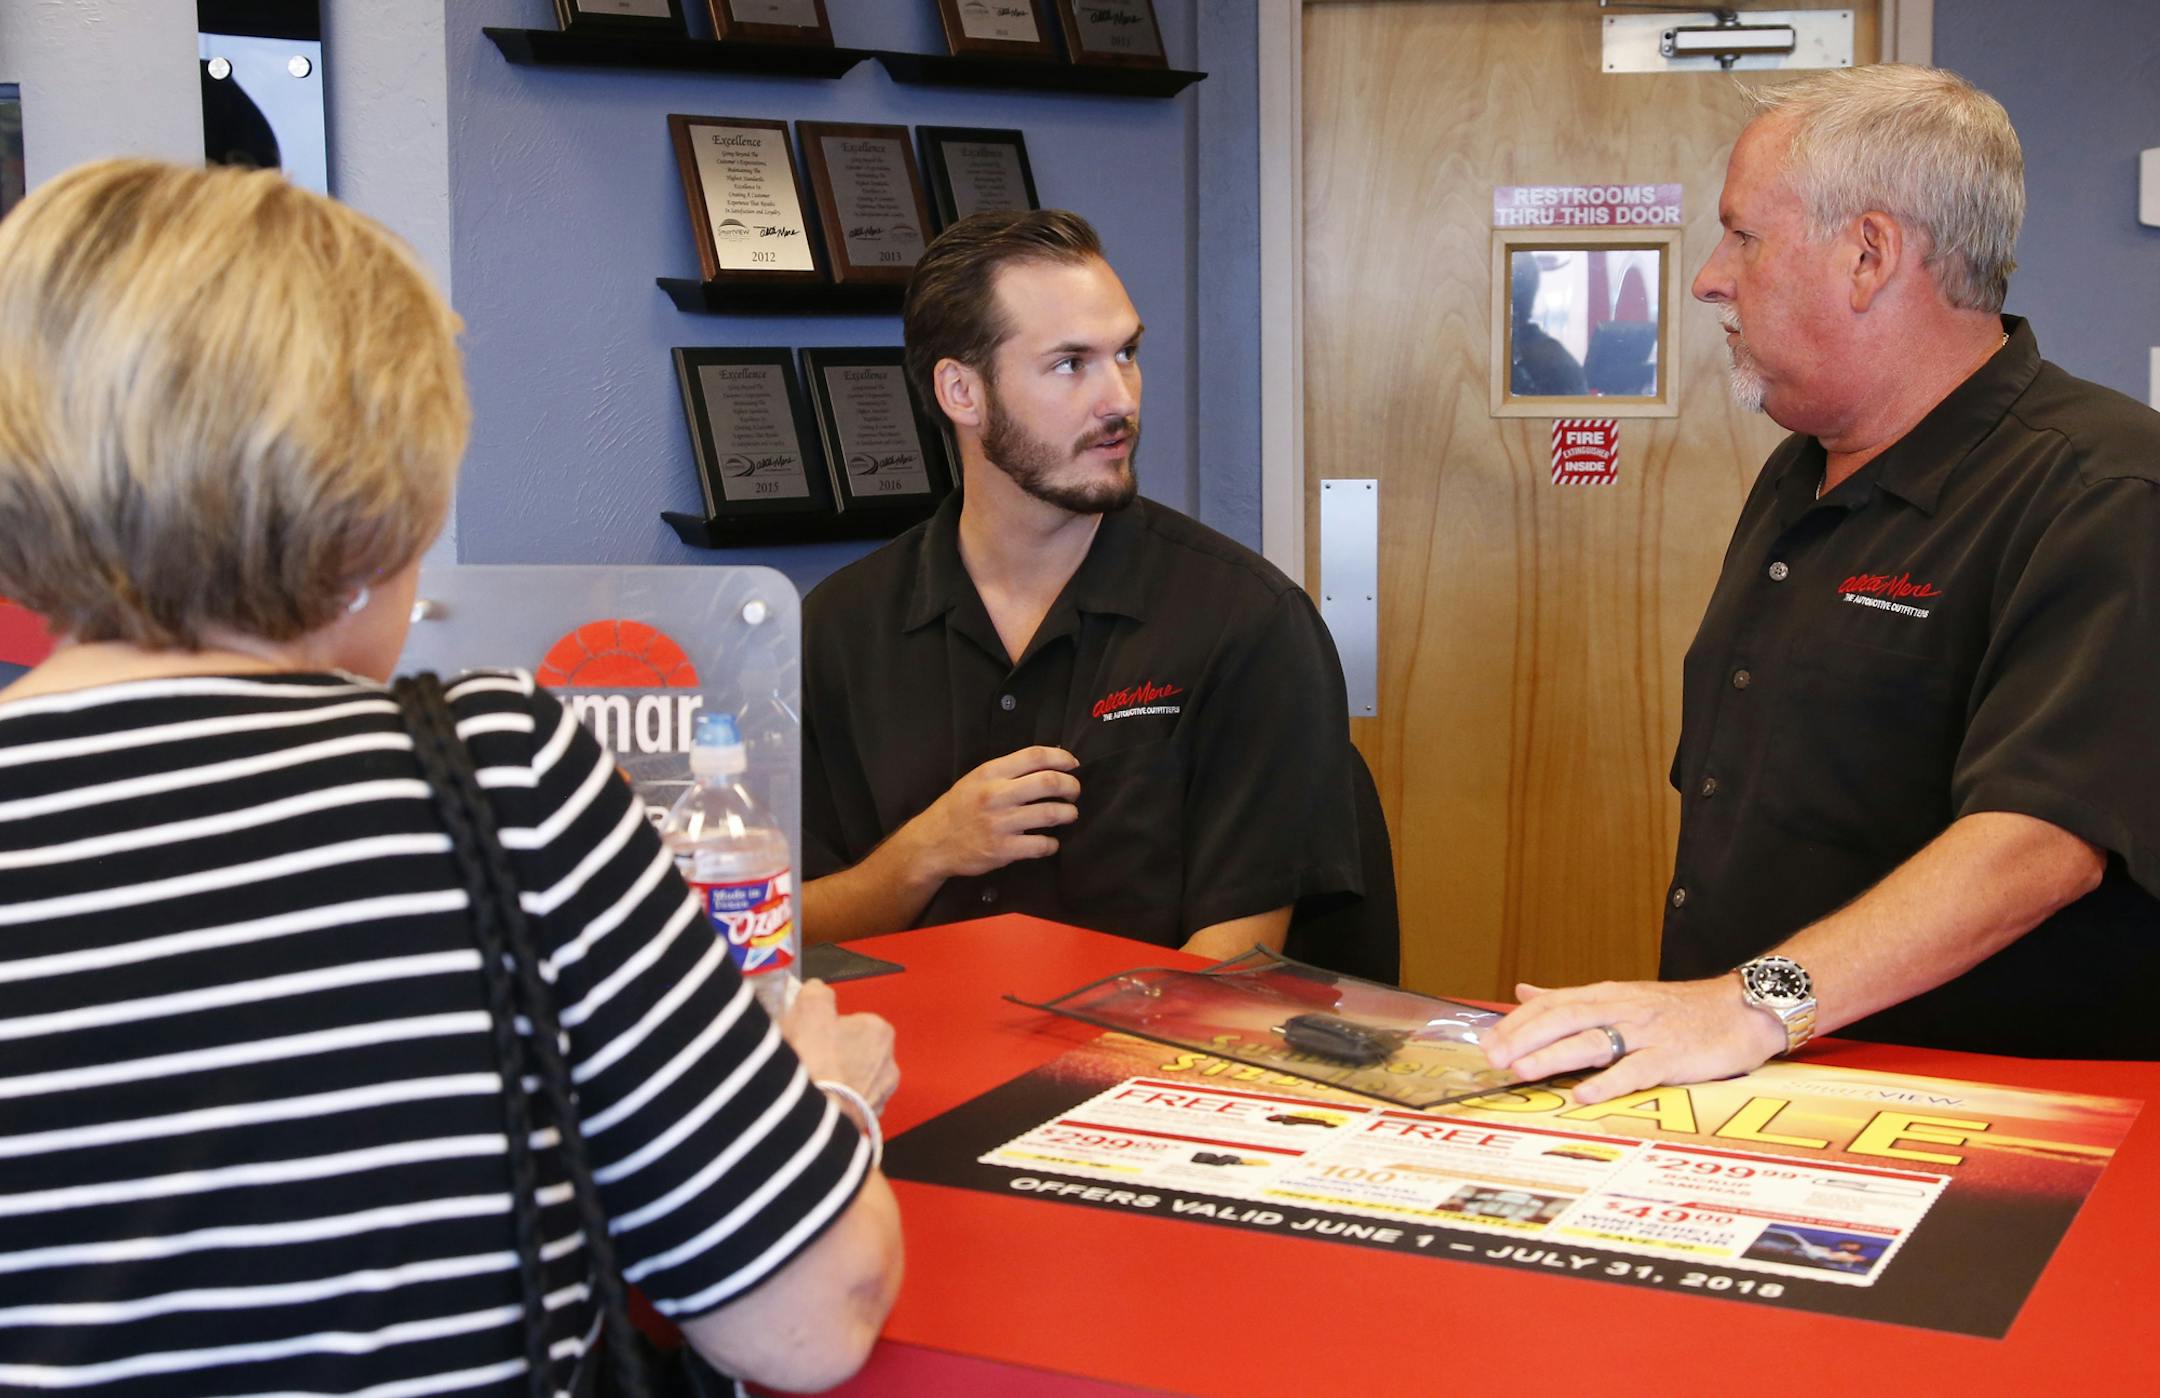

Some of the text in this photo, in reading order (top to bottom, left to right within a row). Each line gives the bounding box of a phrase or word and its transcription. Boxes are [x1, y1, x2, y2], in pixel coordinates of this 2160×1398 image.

[712, 134, 762, 148] Excellence
[841, 142, 887, 154] Excellence
[1514, 187, 1656, 204] RESTROOMS
[1496, 206, 1681, 226] THRU THIS DOOR
[752, 251, 776, 262] 2012
[879, 251, 902, 262] 2013
[719, 368, 767, 380] Excellence
[844, 369, 888, 381] Excellence
[1566, 431, 1605, 445] FIRE
[1565, 461, 1606, 472] INSIDE
[755, 481, 779, 493] 2015
[879, 479, 902, 491] 2016
[1843, 593, 1930, 618] THE AUTOMOTIVE OUTFITTERS
[1103, 706, 1180, 721] THE AUTOMOTIVE OUTFITTERS
[557, 692, 703, 753] mar
[748, 888, 761, 899] in
[1446, 1068, 1991, 1166] SALE
[1365, 1119, 1524, 1148] FREE
[1647, 1179, 1752, 1196] CAMERAS
[1661, 1173, 1753, 1188] BACKUP
[1574, 1220, 1731, 1246] CHIP REPAIR
[1578, 1213, 1737, 1239] WINDSHIELD
[1009, 1176, 1161, 1208] OFFERS
[1171, 1198, 1284, 1227] VALID
[1289, 1216, 1404, 1244] JUNE
[1416, 1233, 1435, 1248] 1
[1486, 1245, 1599, 1271] JULY
[1605, 1261, 1665, 1284] 31,
[1678, 1271, 1785, 1299] 2018
